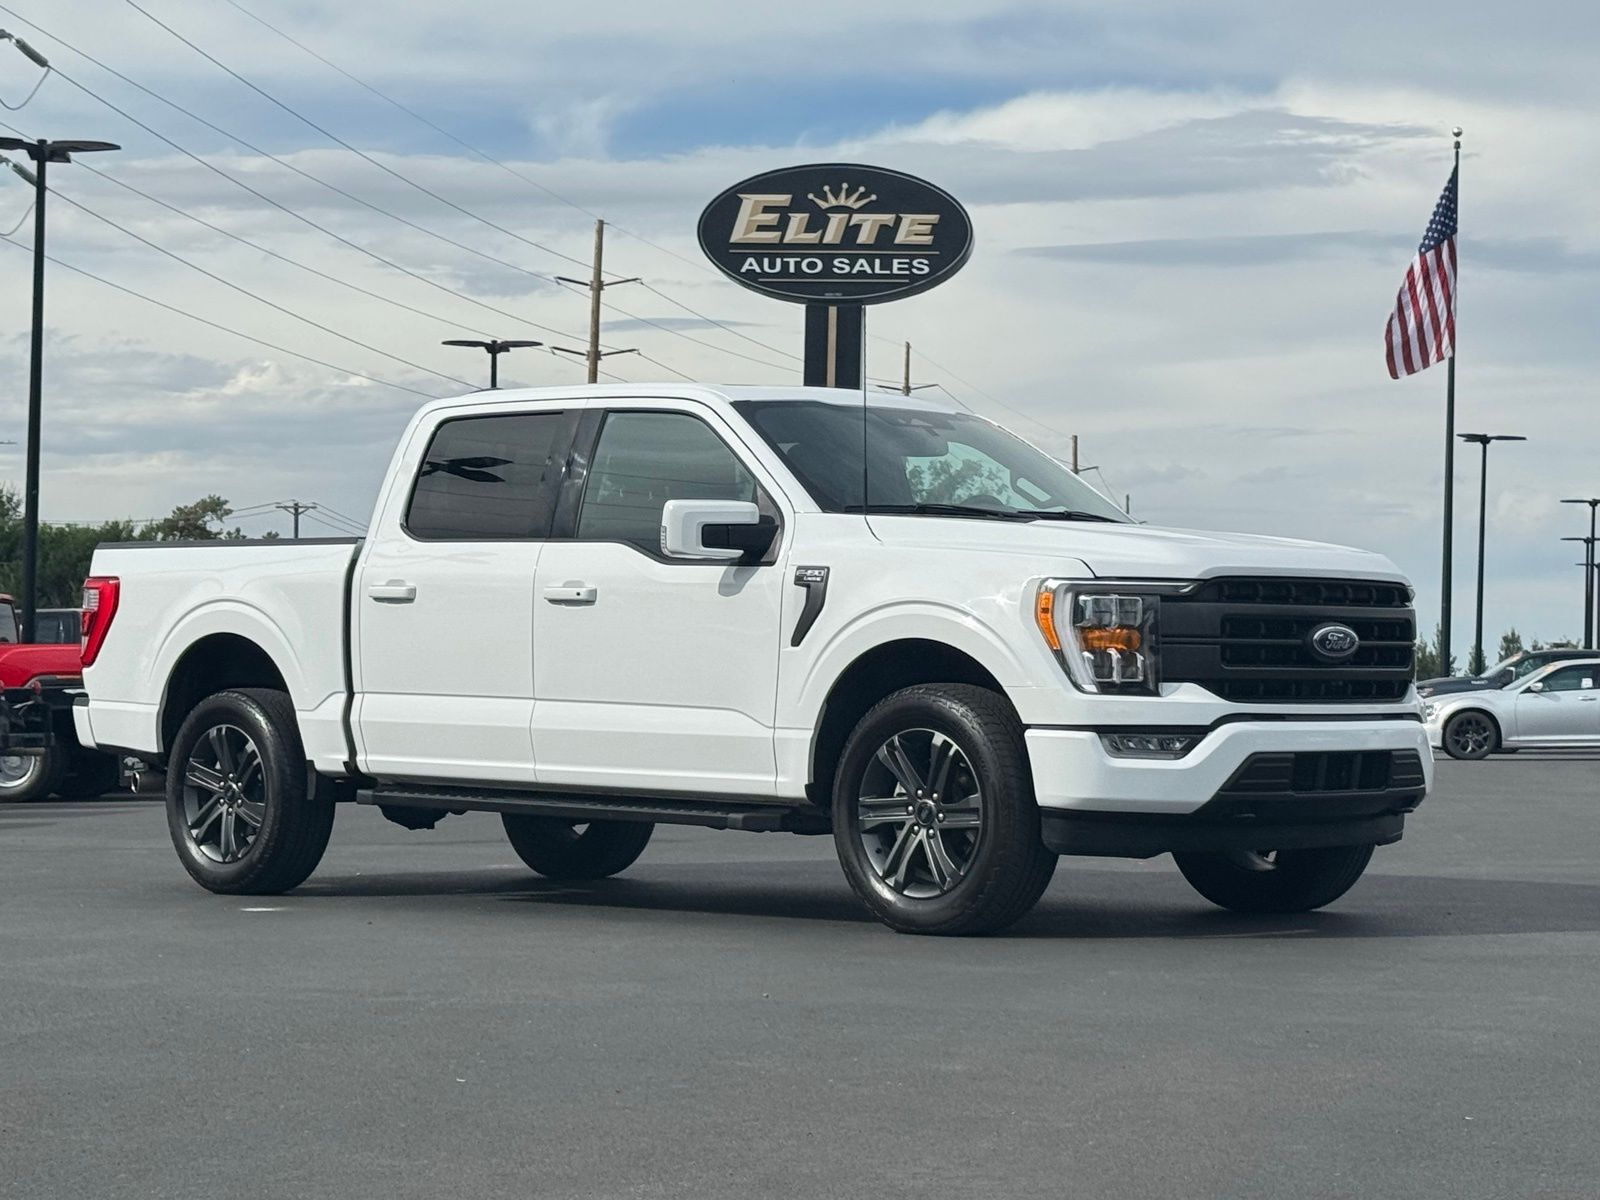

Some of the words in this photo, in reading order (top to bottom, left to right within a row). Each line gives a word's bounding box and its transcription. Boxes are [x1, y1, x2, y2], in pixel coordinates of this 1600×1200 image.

[729, 193, 940, 245] ELITE
[740, 257, 824, 274] AUTO
[832, 258, 930, 275] SALES
[1325, 632, 1351, 649] Ford
